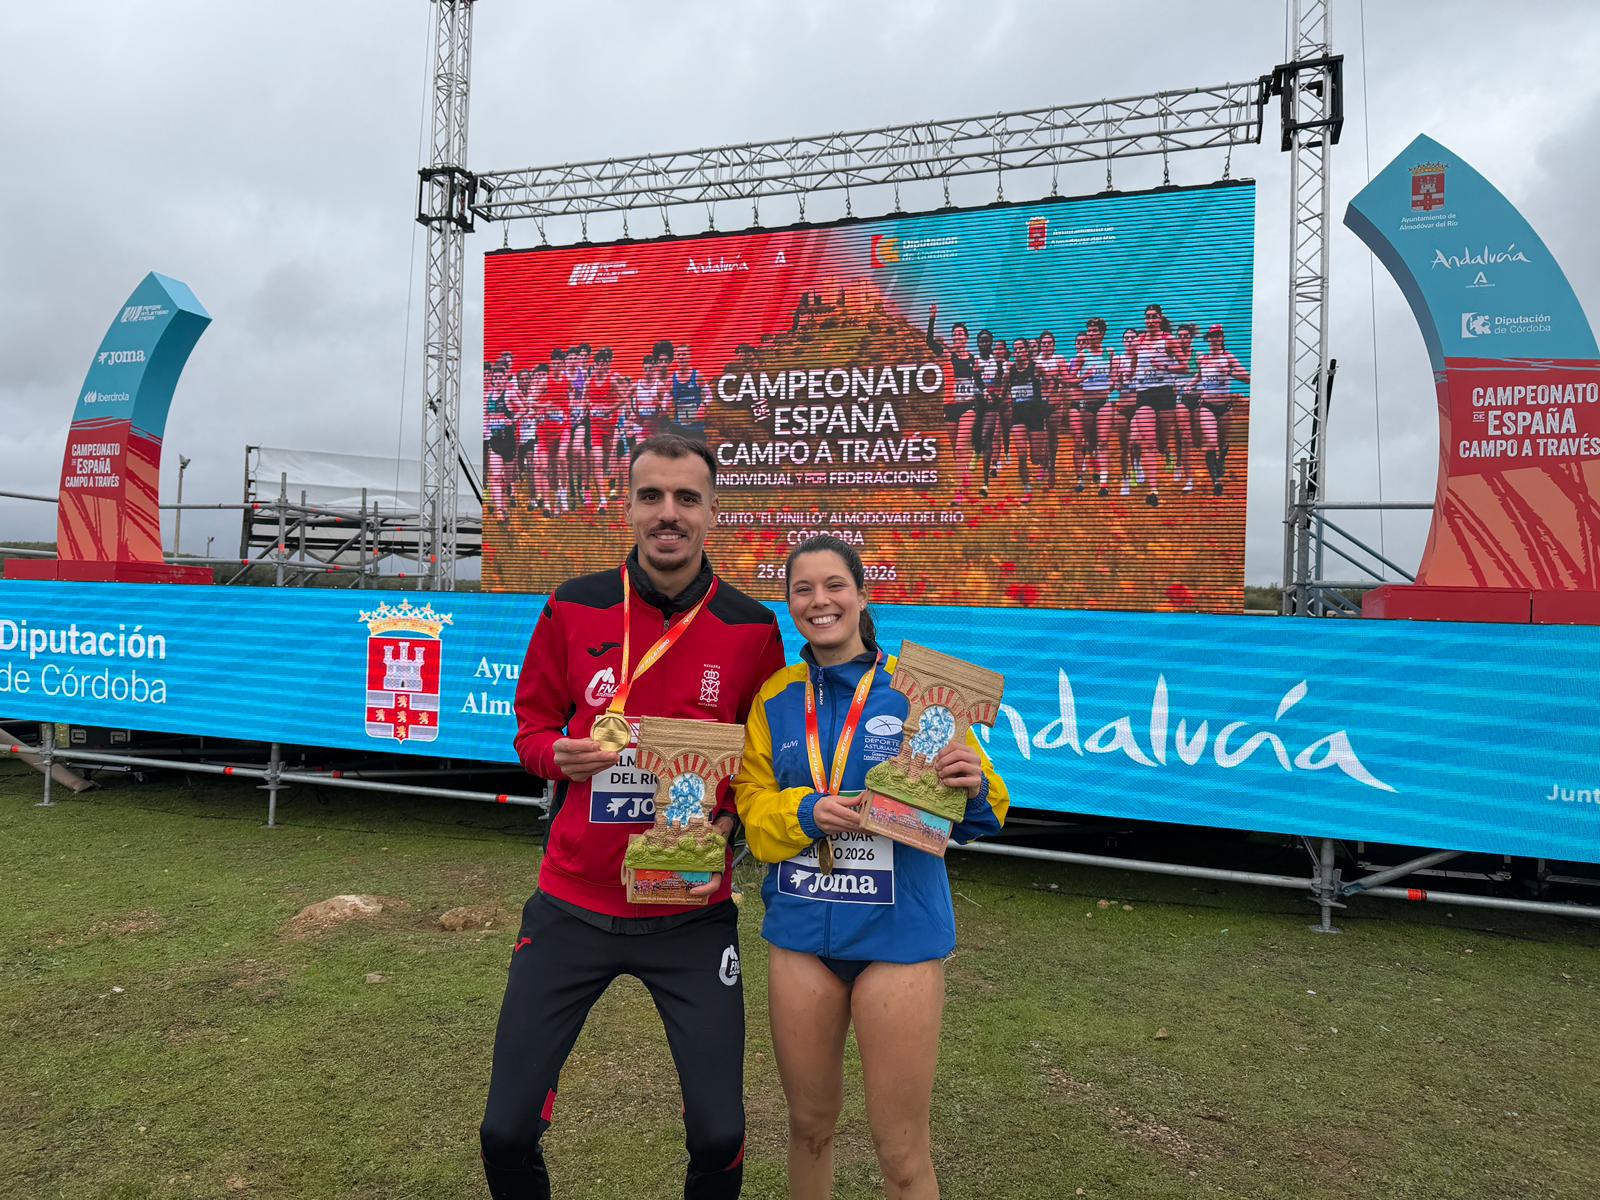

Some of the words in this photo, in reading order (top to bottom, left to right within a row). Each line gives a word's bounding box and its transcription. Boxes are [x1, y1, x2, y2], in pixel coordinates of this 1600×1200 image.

[1431, 243, 1532, 270] Andalucía
[1494, 326, 1507, 334] de
[1509, 324, 1551, 334] Córdoba
[1495, 314, 1551, 325] Diputación
[717, 362, 943, 402] CAMPEONATO
[1472, 382, 1599, 407] CAMPEONATO
[774, 397, 900, 435] ESPAÑA
[1488, 407, 1577, 436] ESPAÑA
[71, 443, 120, 456] CAMPEONATO
[716, 441, 810, 465] CAMPO
[813, 439, 834, 464] A
[837, 432, 937, 464] TRAVÉS
[1459, 439, 1518, 458] CAMPO
[1521, 438, 1533, 457] A
[1536, 433, 1600, 456] TRAVÉS
[77, 457, 111, 474] ESPAÑA
[65, 476, 88, 488] CAMPO
[89, 476, 94, 487] A
[95, 472, 120, 487] TRAVÉS
[715, 472, 794, 486] INDIVIDUAL
[795, 472, 803, 484] Y
[829, 470, 938, 484] FEDERACIONES
[717, 512, 754, 524] CUITO
[757, 564, 775, 579] 25
[0, 619, 166, 660] Diputación
[0, 661, 31, 693] de
[41, 663, 167, 704] Córdoba
[970, 667, 1399, 793] ndalucía
[610, 773, 638, 785] DEL
[1546, 783, 1600, 804] Junt
[844, 847, 875, 861] 2026
